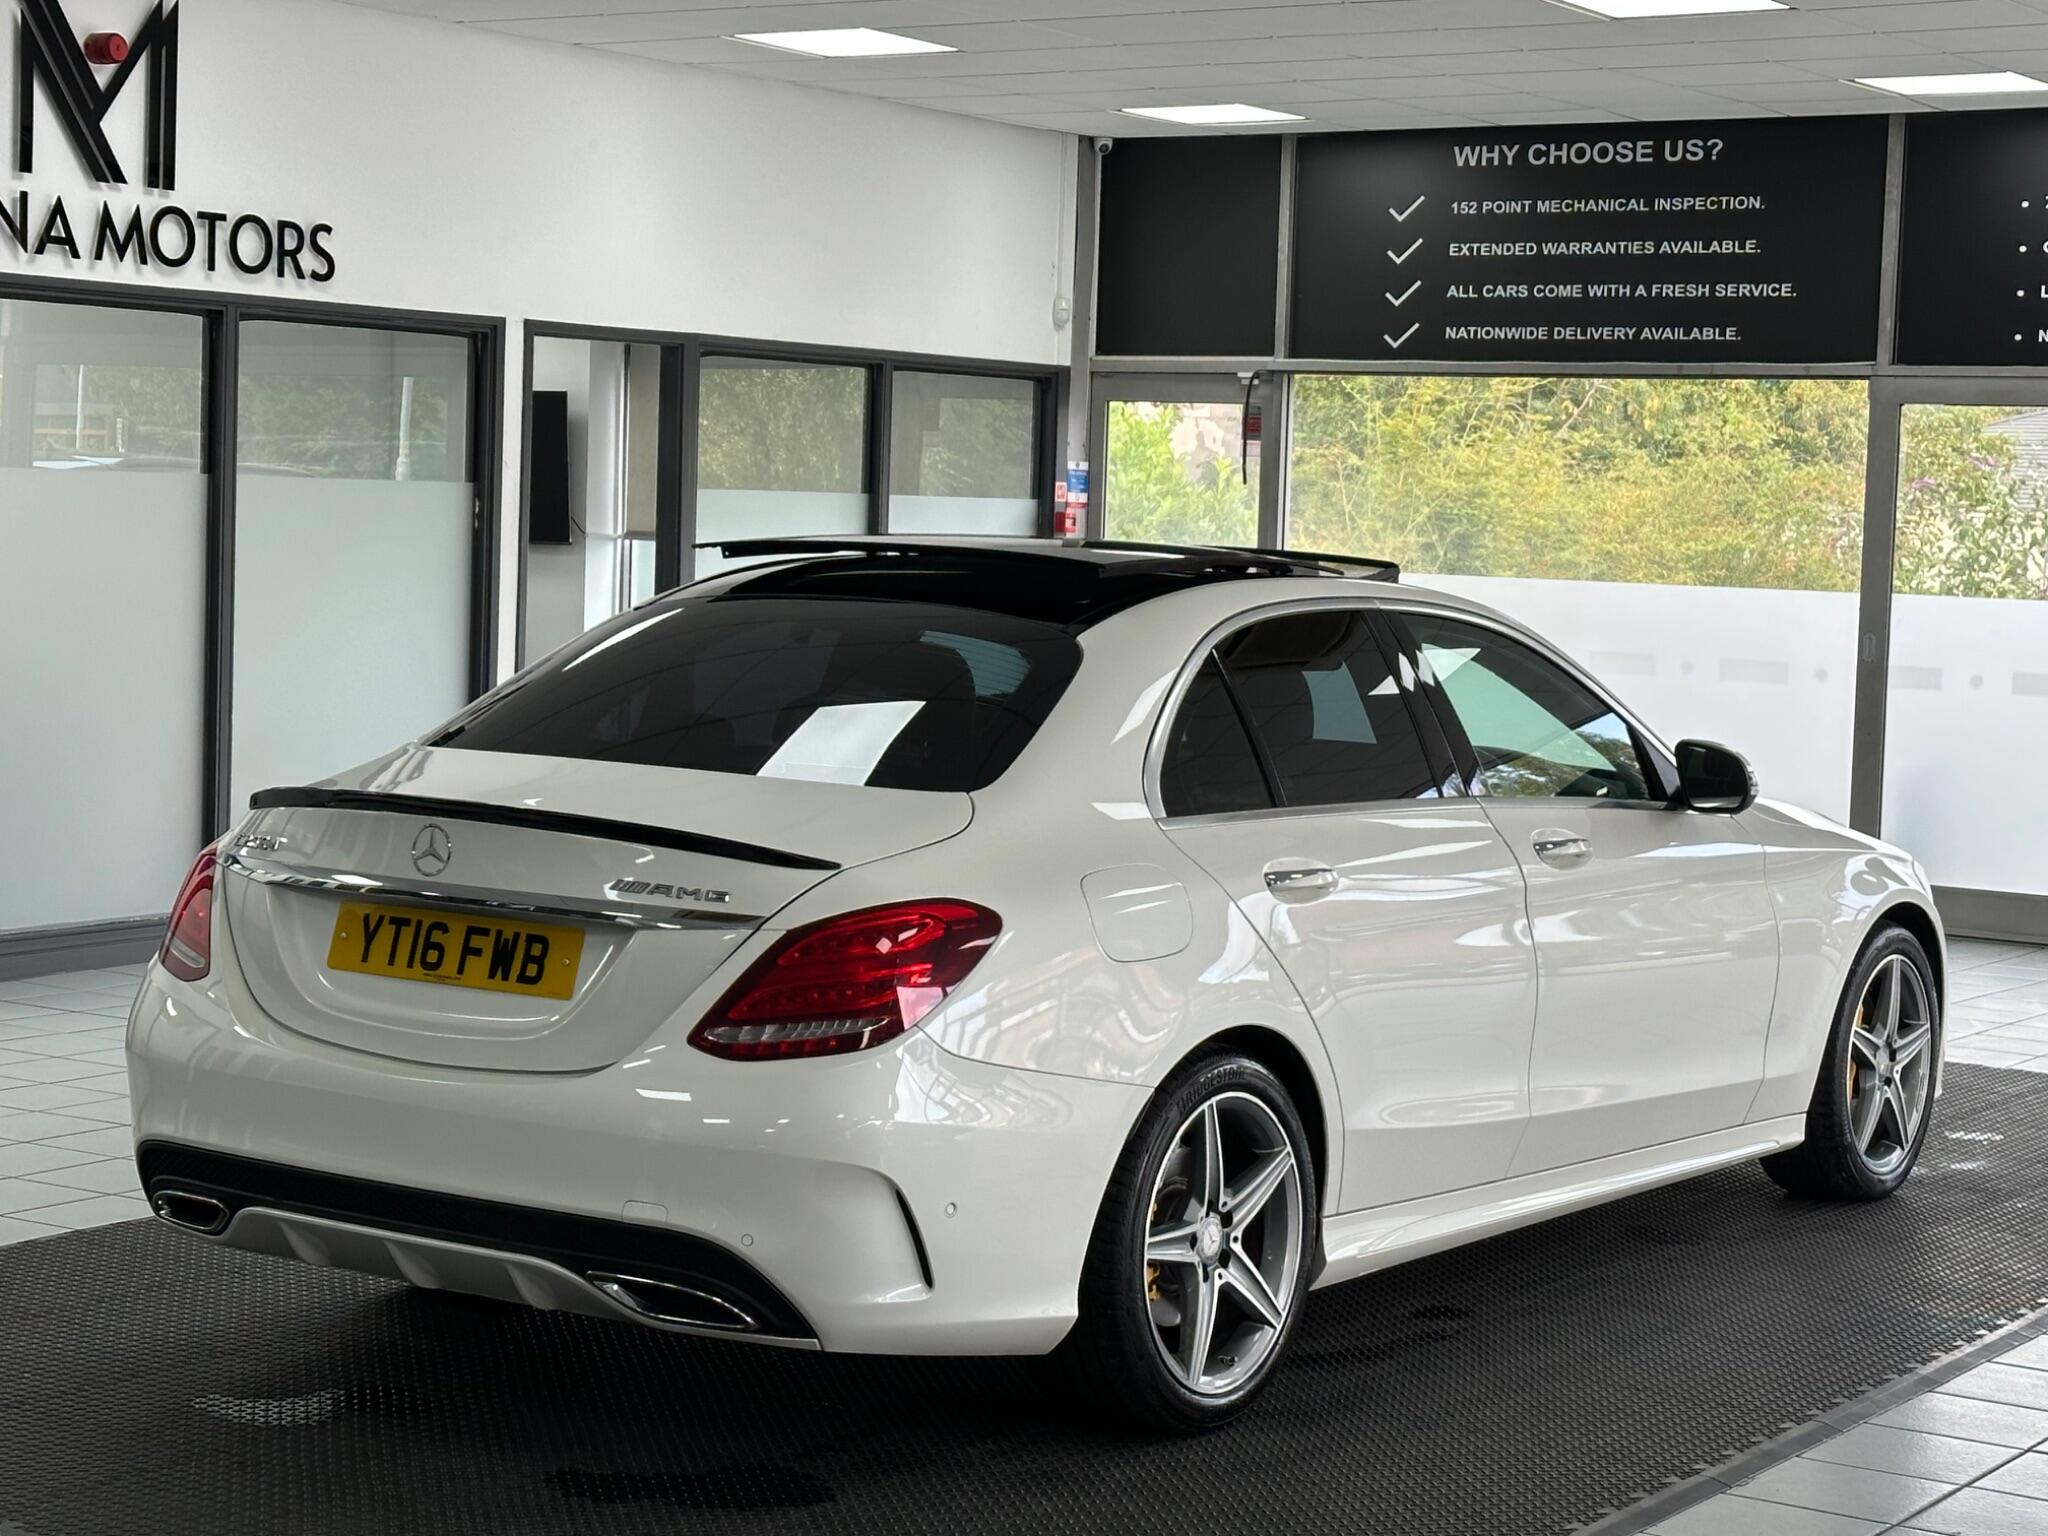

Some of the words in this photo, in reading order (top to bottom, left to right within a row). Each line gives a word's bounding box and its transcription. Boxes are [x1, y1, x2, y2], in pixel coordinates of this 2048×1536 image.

[1453, 144, 1520, 167] WHY
[1528, 140, 1654, 165] CHOOSE
[1664, 138, 1724, 162] US?
[1450, 200, 1478, 215] 152
[1482, 199, 1533, 214] POINT
[1536, 198, 1650, 214] MECHANICAL
[1654, 195, 1766, 211] INSPECTION.
[94, 200, 336, 282] MOTORS
[1448, 242, 1538, 257] EXTENDED
[1541, 240, 1655, 256] WARRANTIES
[1658, 239, 1762, 254] AVAILABLE.
[1446, 284, 1479, 299] ALL
[1482, 284, 1529, 298] CARS
[1533, 284, 1583, 298] COME
[1587, 284, 1631, 298] WITH
[1634, 284, 1648, 298] A
[1651, 283, 1710, 298] FRESH
[1714, 283, 1797, 297] SERVICE.
[1444, 326, 1549, 340] NATIONWIDE
[1553, 326, 1637, 341] DELIVERY
[1639, 326, 1742, 341] AVAILABLE.
[646, 882, 729, 904] AMG
[360, 913, 450, 973] YT16
[455, 925, 550, 986] FWB
